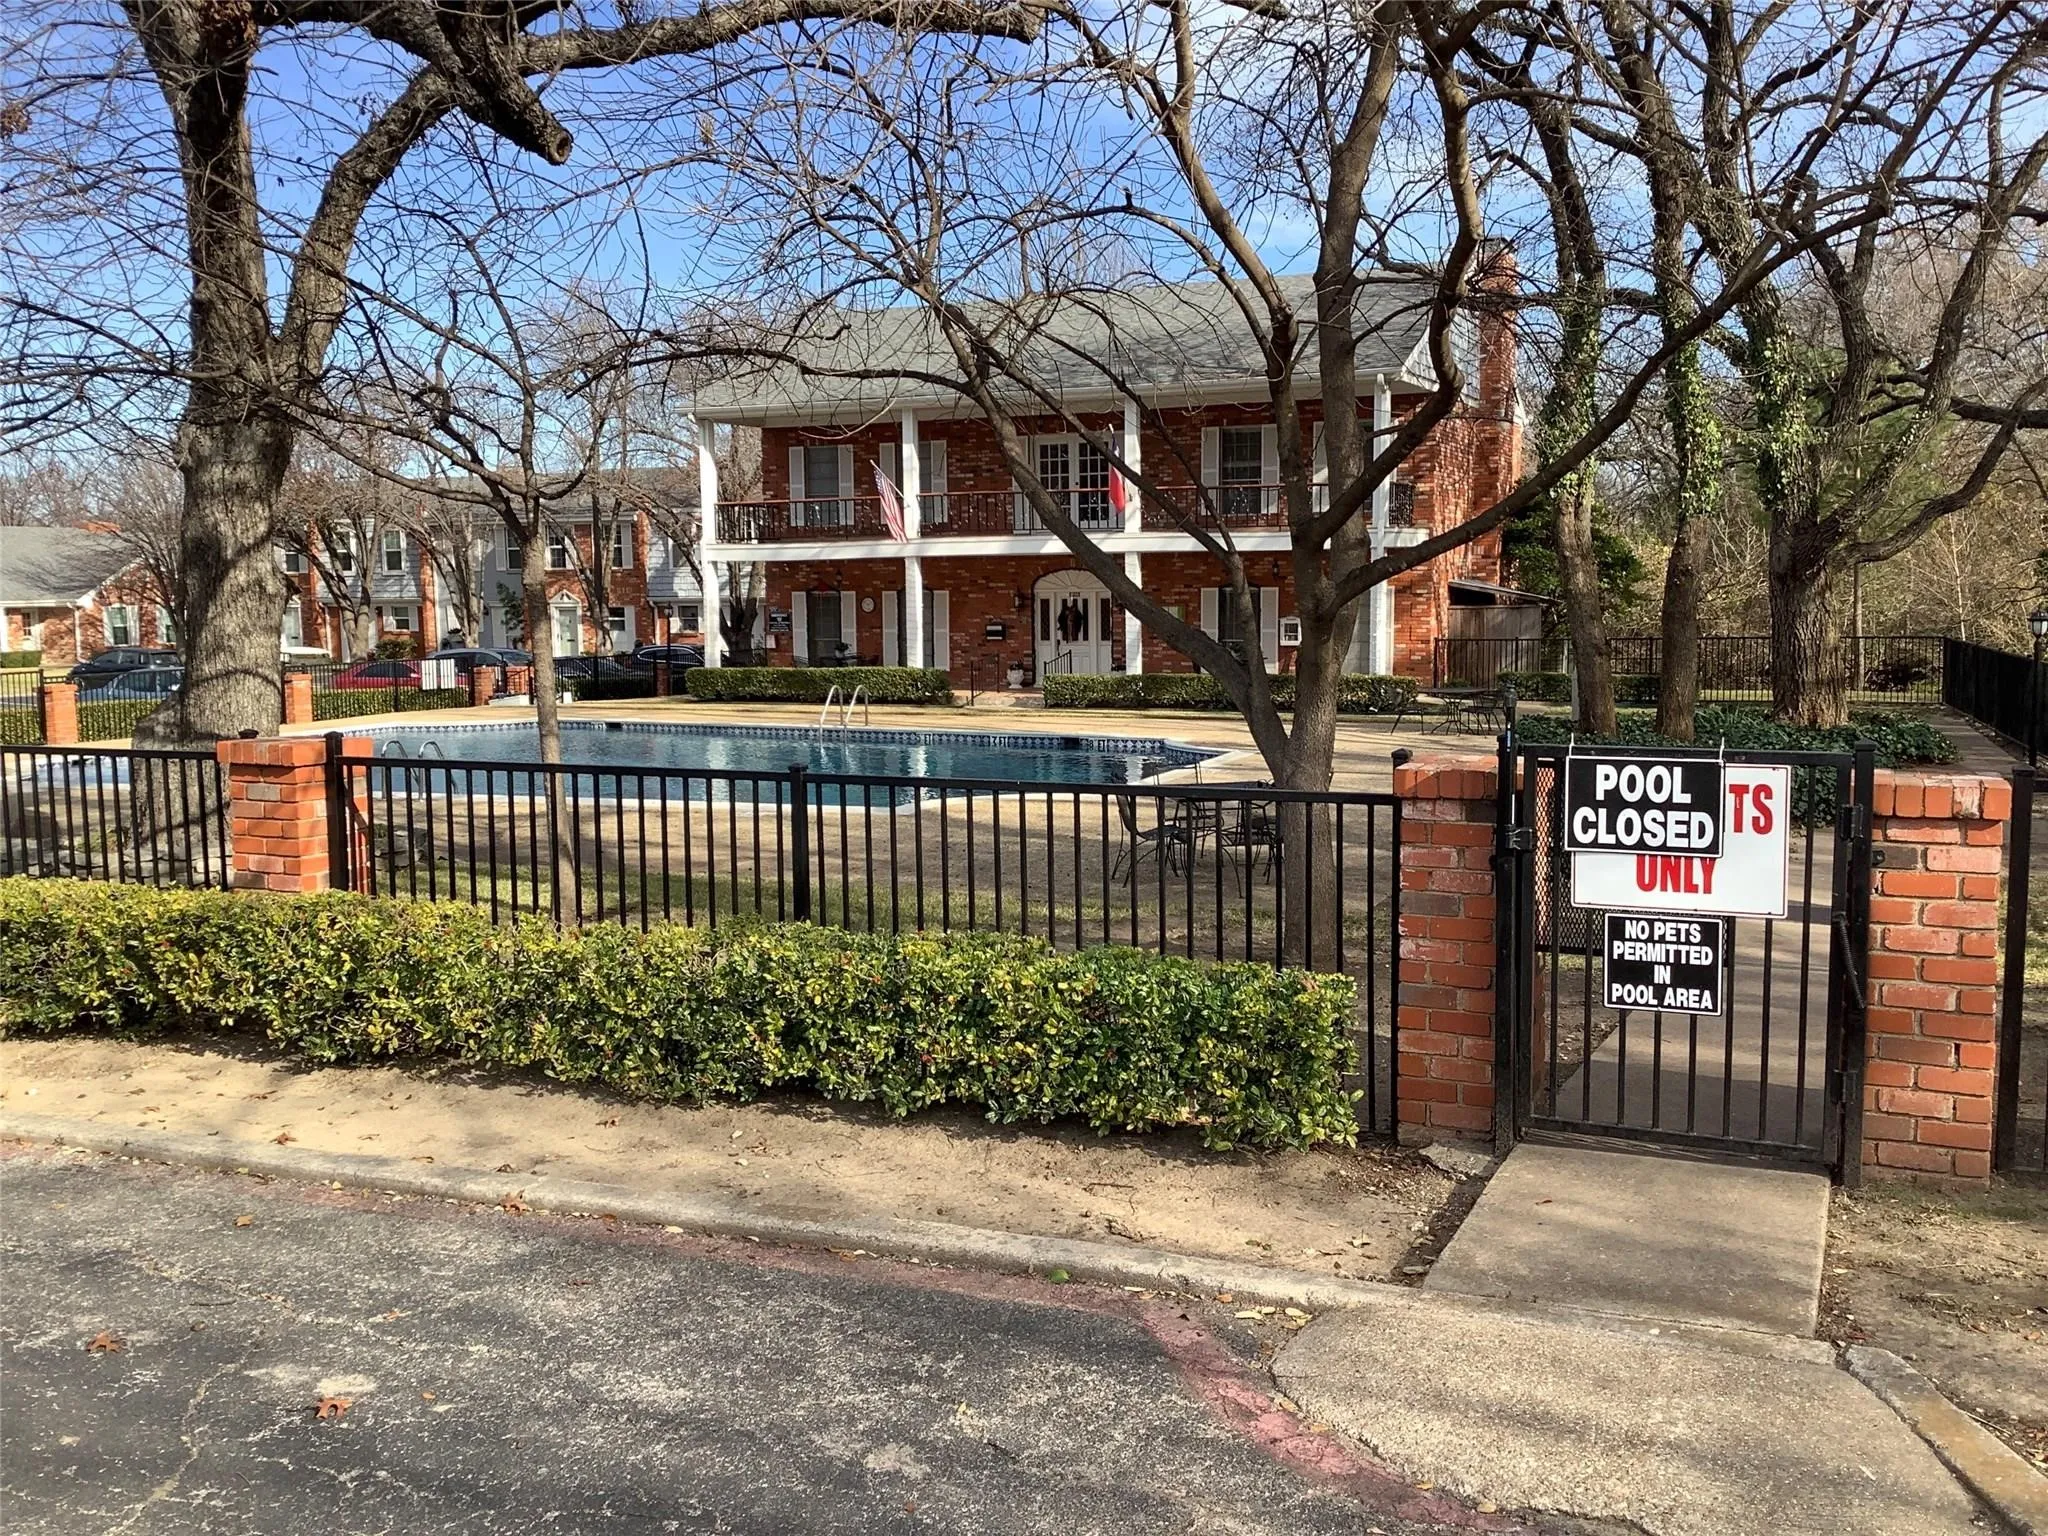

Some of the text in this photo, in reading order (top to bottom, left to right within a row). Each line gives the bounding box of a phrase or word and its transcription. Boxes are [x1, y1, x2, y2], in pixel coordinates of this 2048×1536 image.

[1595, 764, 1692, 804] POOL
[1728, 783, 1774, 835] TS
[1572, 806, 1715, 849] CLOSED
[1635, 854, 1717, 895] ONLY
[1624, 919, 1702, 944] NO PETS
[1612, 940, 1714, 966] PERMITTED
[1653, 964, 1671, 985] IN
[1611, 982, 1713, 1010] POOL AREA
